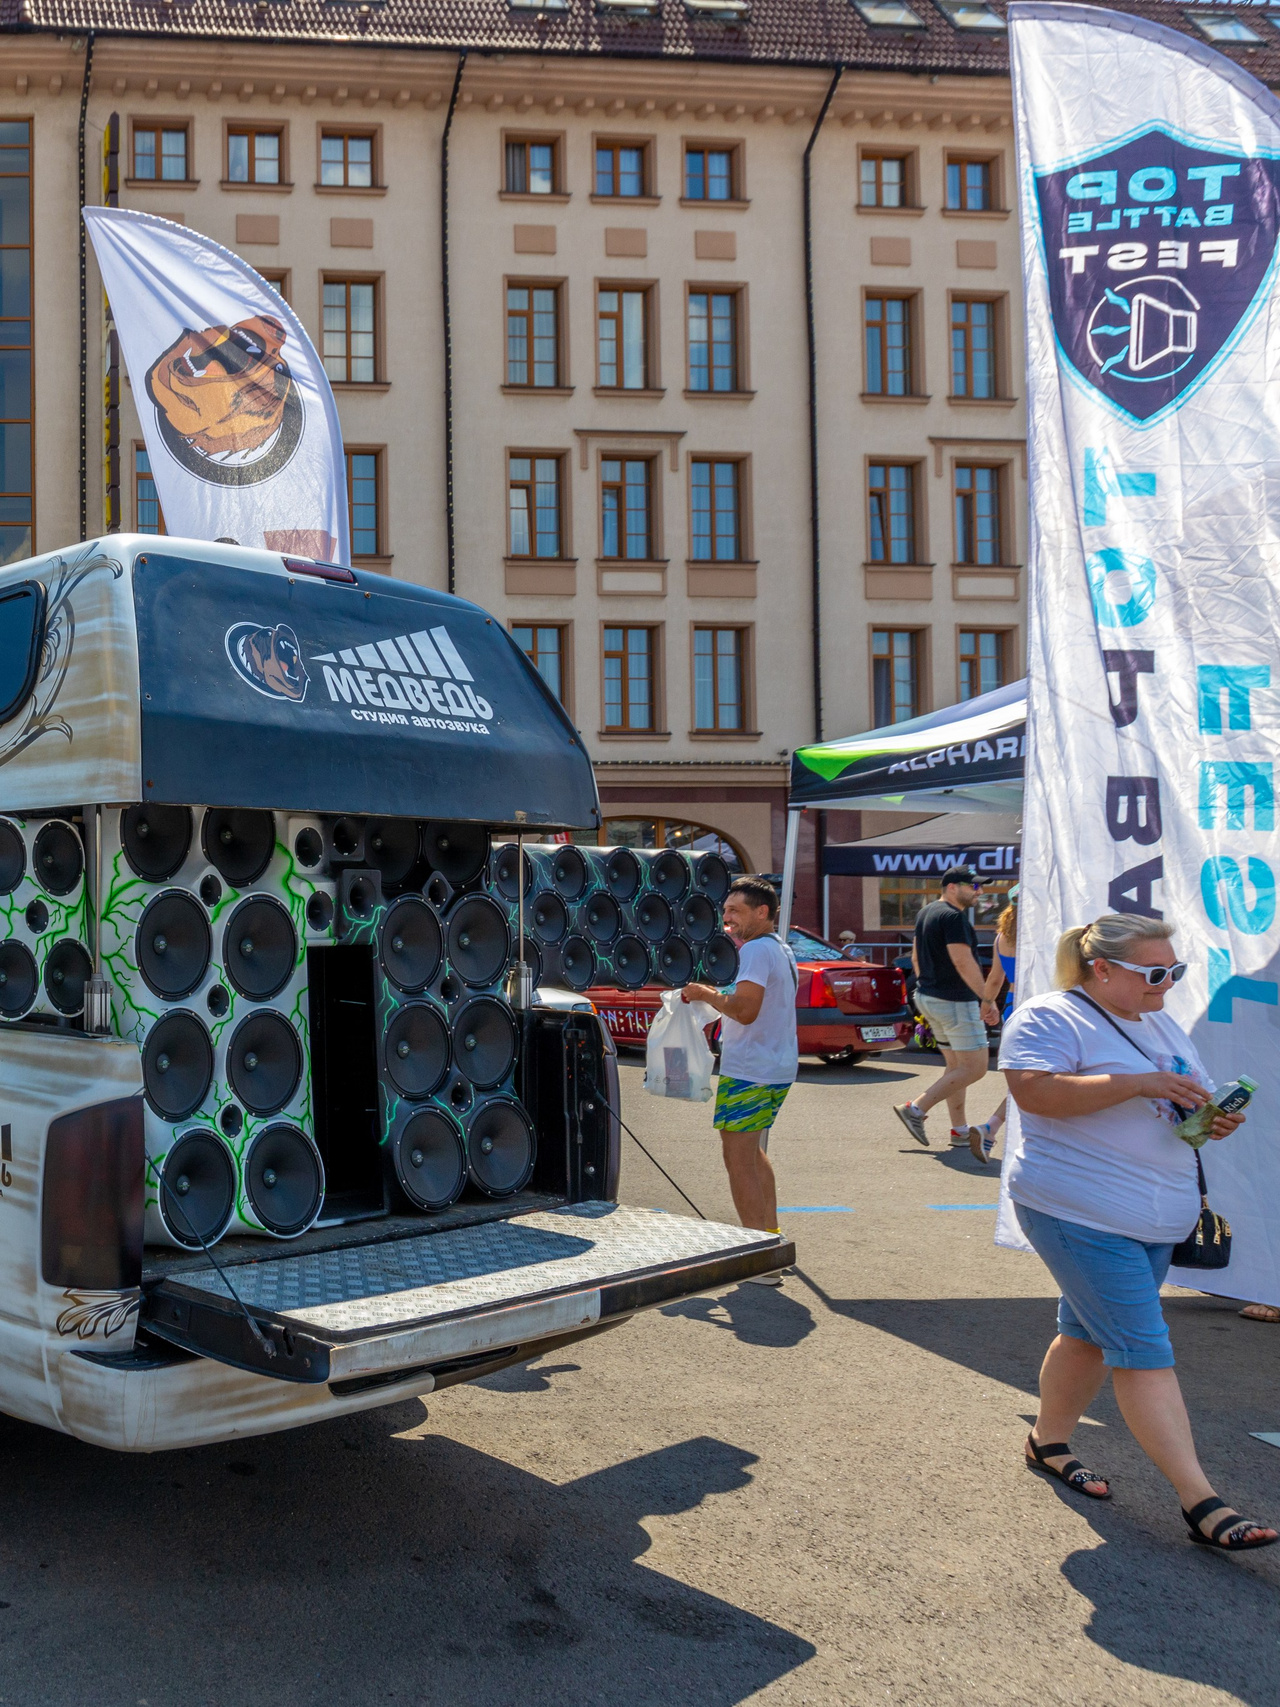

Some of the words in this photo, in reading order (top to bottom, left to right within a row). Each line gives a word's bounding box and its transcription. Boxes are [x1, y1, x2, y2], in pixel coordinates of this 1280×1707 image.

[322, 665, 494, 721] МЕДВЕДЬ
[888, 734, 1026, 775] ALPHAR
[1223, 1096, 1245, 1114] Rich
